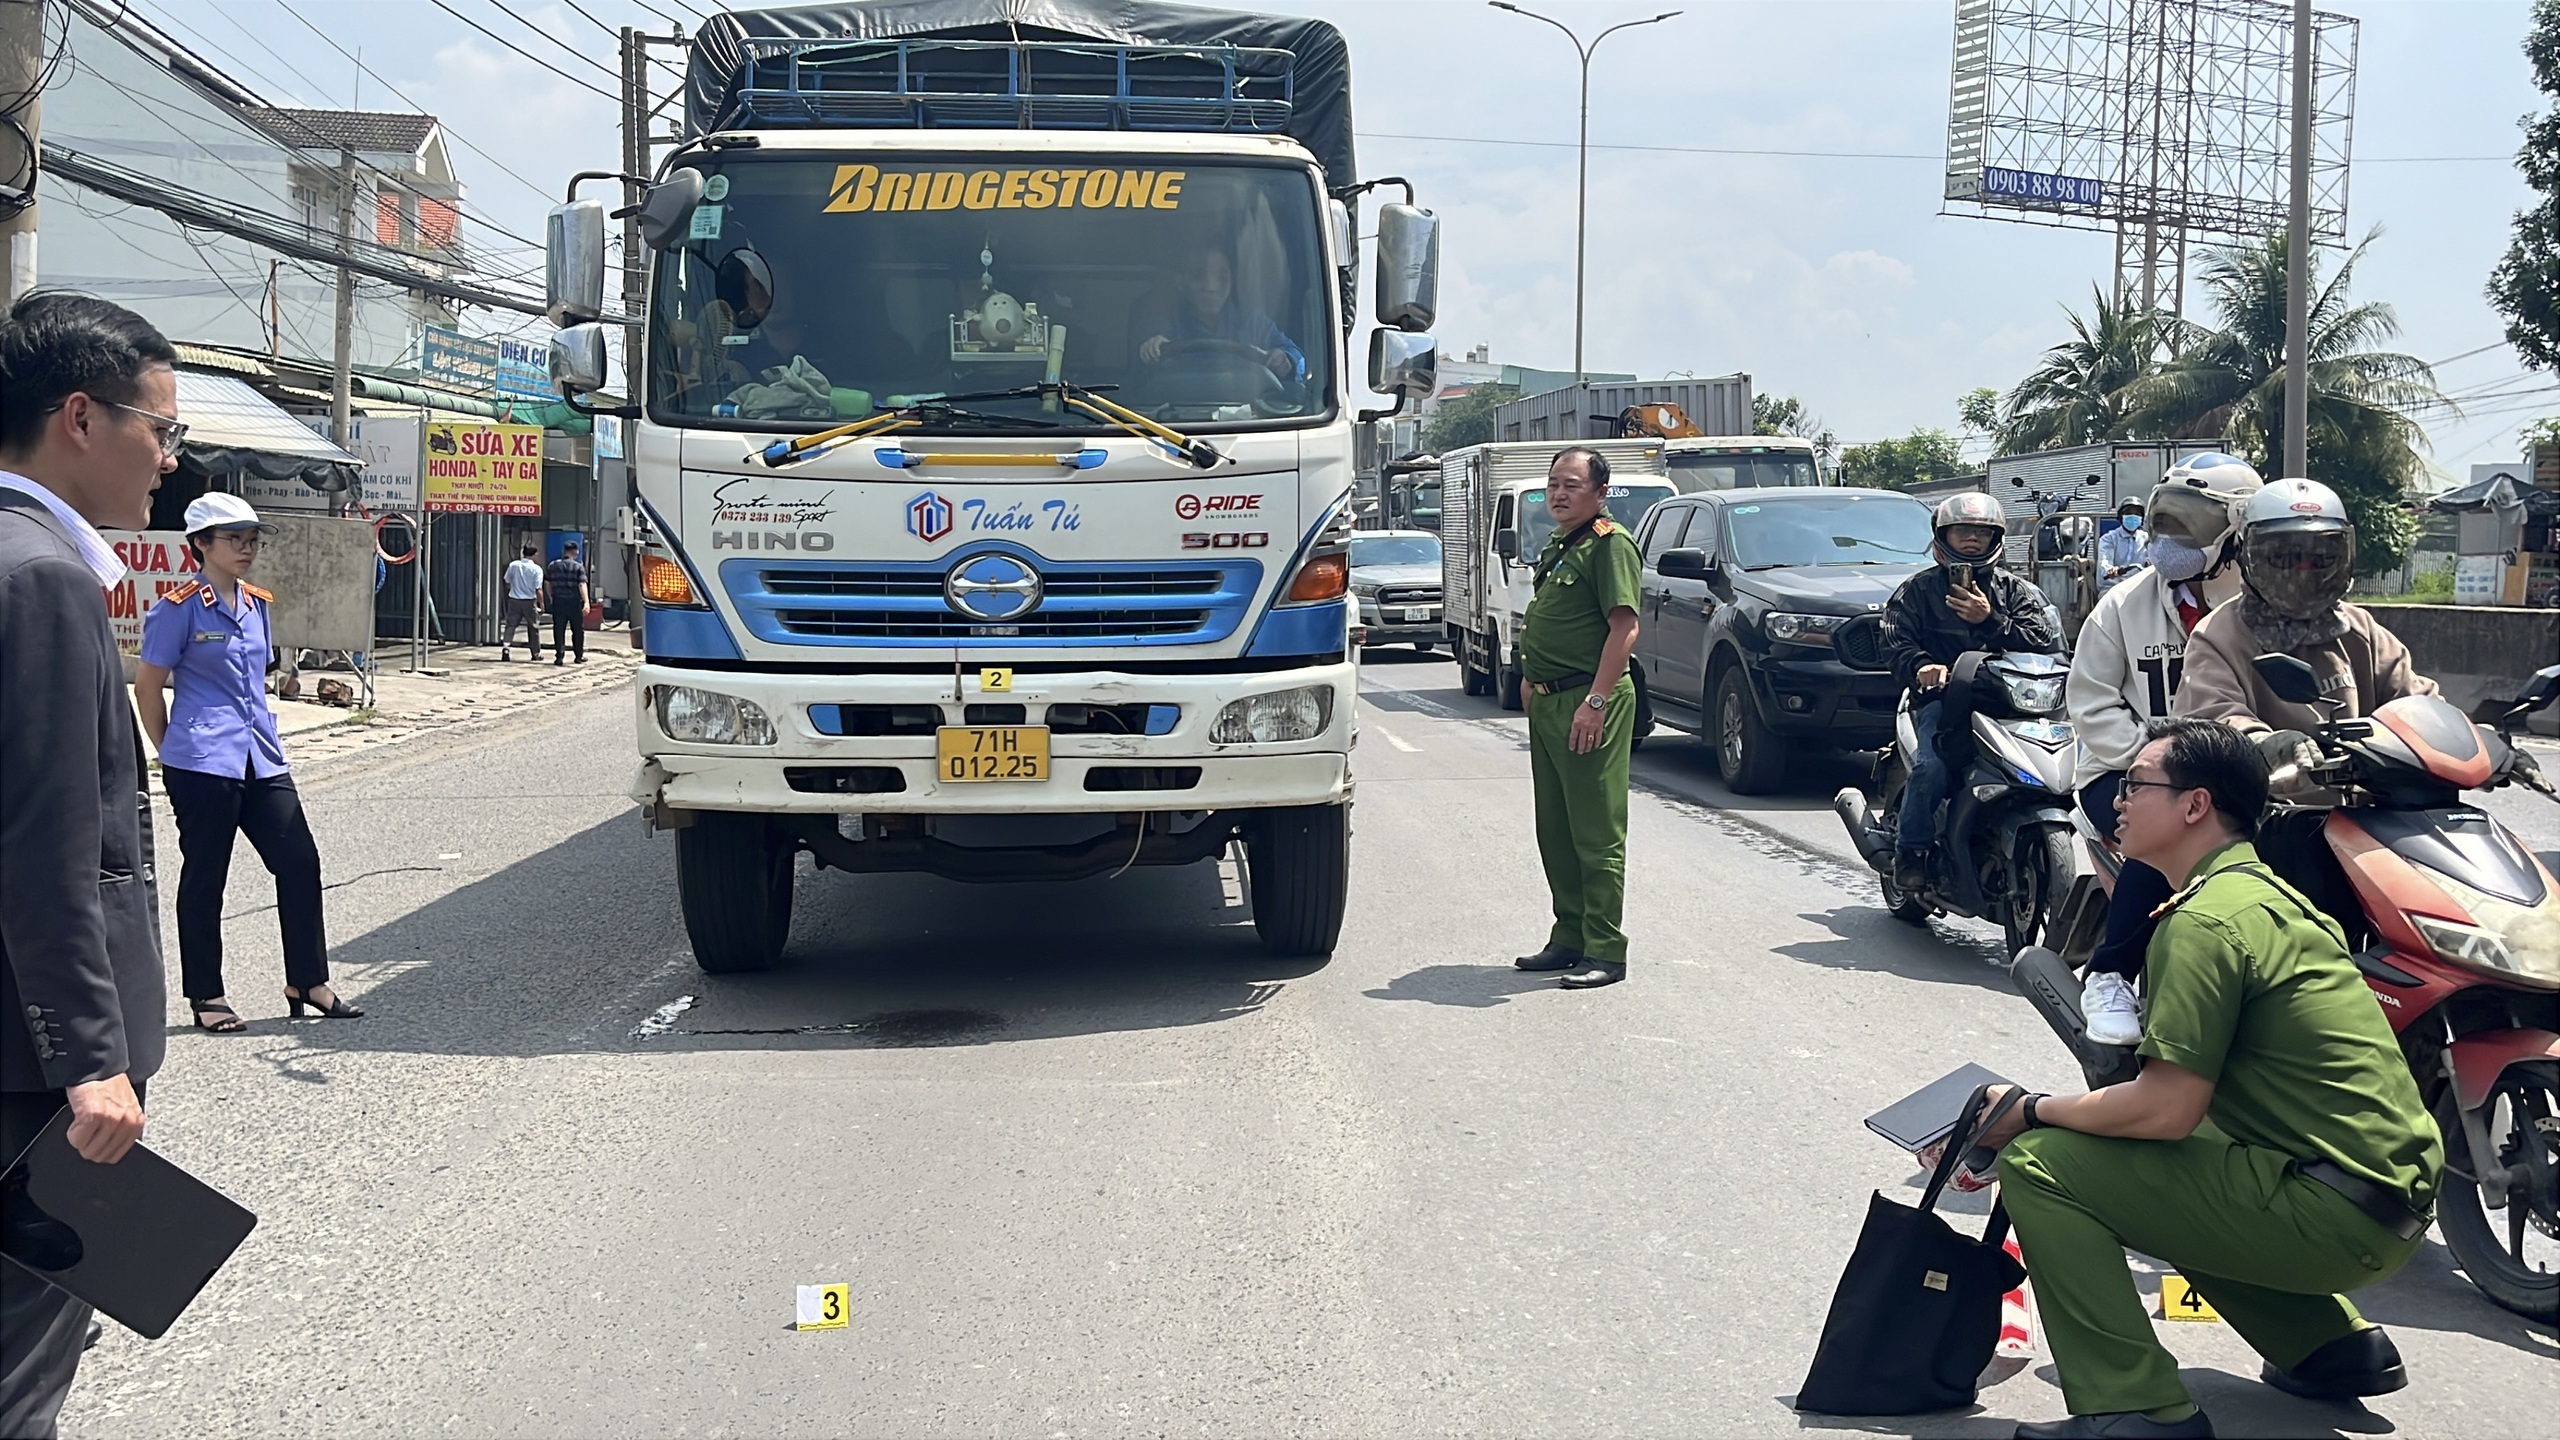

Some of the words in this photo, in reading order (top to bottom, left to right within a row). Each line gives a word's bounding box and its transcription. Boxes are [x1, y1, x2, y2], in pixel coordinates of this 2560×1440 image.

[821, 164, 1186, 214] BRIDGESTONE
[1988, 168, 2027, 195] 0903
[2032, 175, 2052, 198] 88
[2056, 177, 2076, 200] 98
[2080, 180, 2099, 203] 00
[532, 347, 548, 367] CƠ
[461, 425, 505, 456] SỬA
[511, 434, 538, 457] XE
[429, 459, 477, 478] HONDA
[492, 461, 514, 479] TAY
[519, 462, 538, 480] GA
[431, 503, 452, 511] ĐT:
[456, 504, 484, 512] 0386
[488, 504, 509, 513] 219
[513, 505, 535, 514] 890
[1203, 494, 1264, 511] RIDE
[721, 511, 747, 522] 0373
[750, 512, 769, 523] 233
[773, 513, 791, 523] 139
[962, 499, 1034, 531] Tuấn
[1042, 499, 1081, 532] Tú
[712, 531, 834, 551] HINO
[1182, 532, 1269, 550] 500
[114, 535, 171, 573] SỬA
[179, 544, 199, 573] X
[103, 579, 138, 620] NDA
[115, 622, 141, 635] THẾ
[990, 671, 1003, 687] 2
[970, 730, 1018, 753] 71H
[951, 755, 1038, 779] 012.25
[2374, 990, 2402, 1008] NDA
[823, 1290, 840, 1320] 3
[2180, 1286, 2203, 1313] 4
